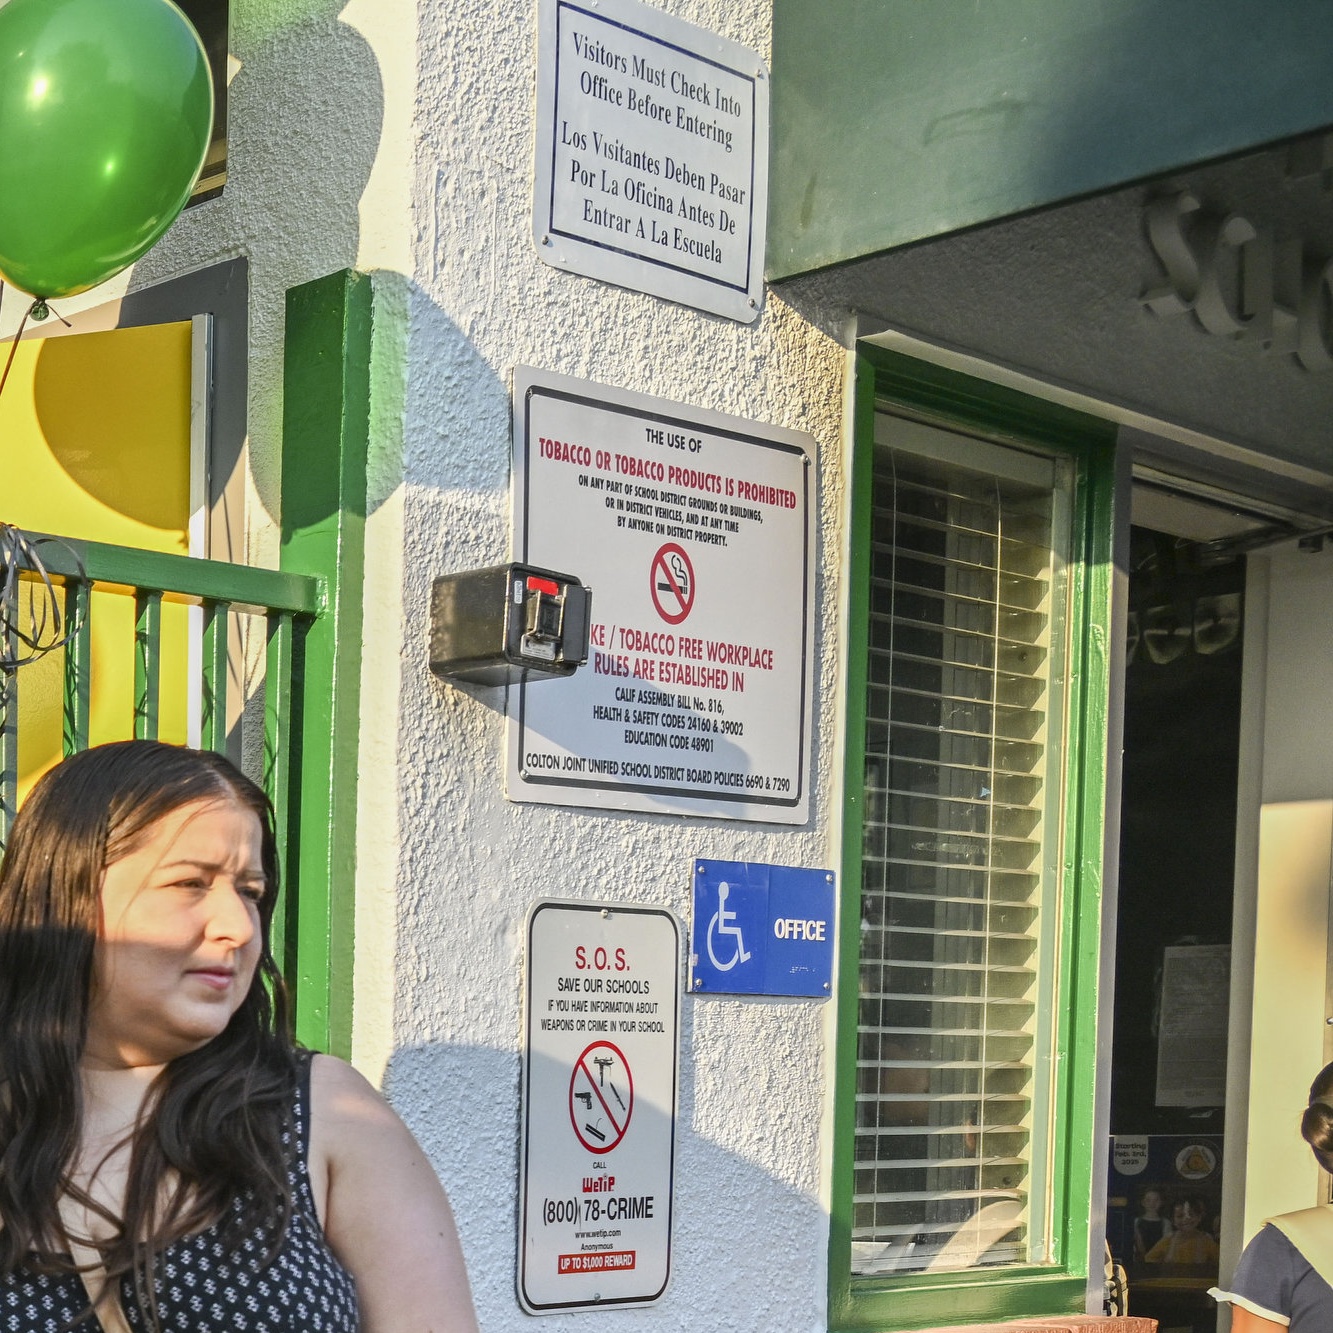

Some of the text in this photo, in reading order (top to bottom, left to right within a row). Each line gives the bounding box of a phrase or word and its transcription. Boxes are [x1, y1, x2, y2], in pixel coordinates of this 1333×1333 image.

[573, 32, 741, 117] Visitors Must Check Into
[581, 71, 732, 153] Office Before Entering
[562, 121, 745, 205] Los Visitantes Deben Pasar
[571, 159, 735, 235] Por La Oficina Antes De
[583, 199, 722, 264] Entrar A La Escuela
[646, 428, 702, 453] THE USE OF
[539, 437, 796, 509] TOBACCO OR TOBACCO PRODUCTS IS PROHIBITED
[578, 474, 763, 524] ON ANY PART OF SCHOOL DISTRICT GROUNDS OR BUILDINGS,
[605, 497, 739, 533] OR IN DISTRICT VEHICLES, AND AT ANY TIME
[617, 516, 727, 547] BY ANYONE ON DISTRICT PROPERTY.
[620, 628, 674, 656] TOBACCO
[678, 637, 703, 660] FREE
[706, 641, 773, 670] WORKPLACE
[594, 652, 744, 692] RULES ARE ESTABLISHED IN
[615, 687, 724, 715] CALIF ASSEMBLY BILL No. 816,
[593, 705, 743, 736] HEALTH & SAFETY CODES 24160 & 39002
[625, 730, 714, 753] EDUCATION CODE 48901
[526, 753, 790, 792] COLTON JOINT UNIFIED SCHOOL DISTRICT BOARD POLICIES 6690 & 7290
[774, 918, 826, 941] OFFICE
[575, 946, 630, 971] S.O.S.
[558, 977, 650, 994] SAVE OUR SCHOOLS
[548, 1000, 658, 1014] IF YOU HAVE INFORMATION ABOUT
[541, 1019, 665, 1033] WEAPONS OR CRIME IN YOUR SCHOOL
[543, 1196, 654, 1226] (800) 78-CRIME
[575, 1229, 621, 1239] www.wetip.com
[581, 1243, 613, 1252] Anonymous
[561, 1254, 633, 1270] UP TO $1,000 REWARD
